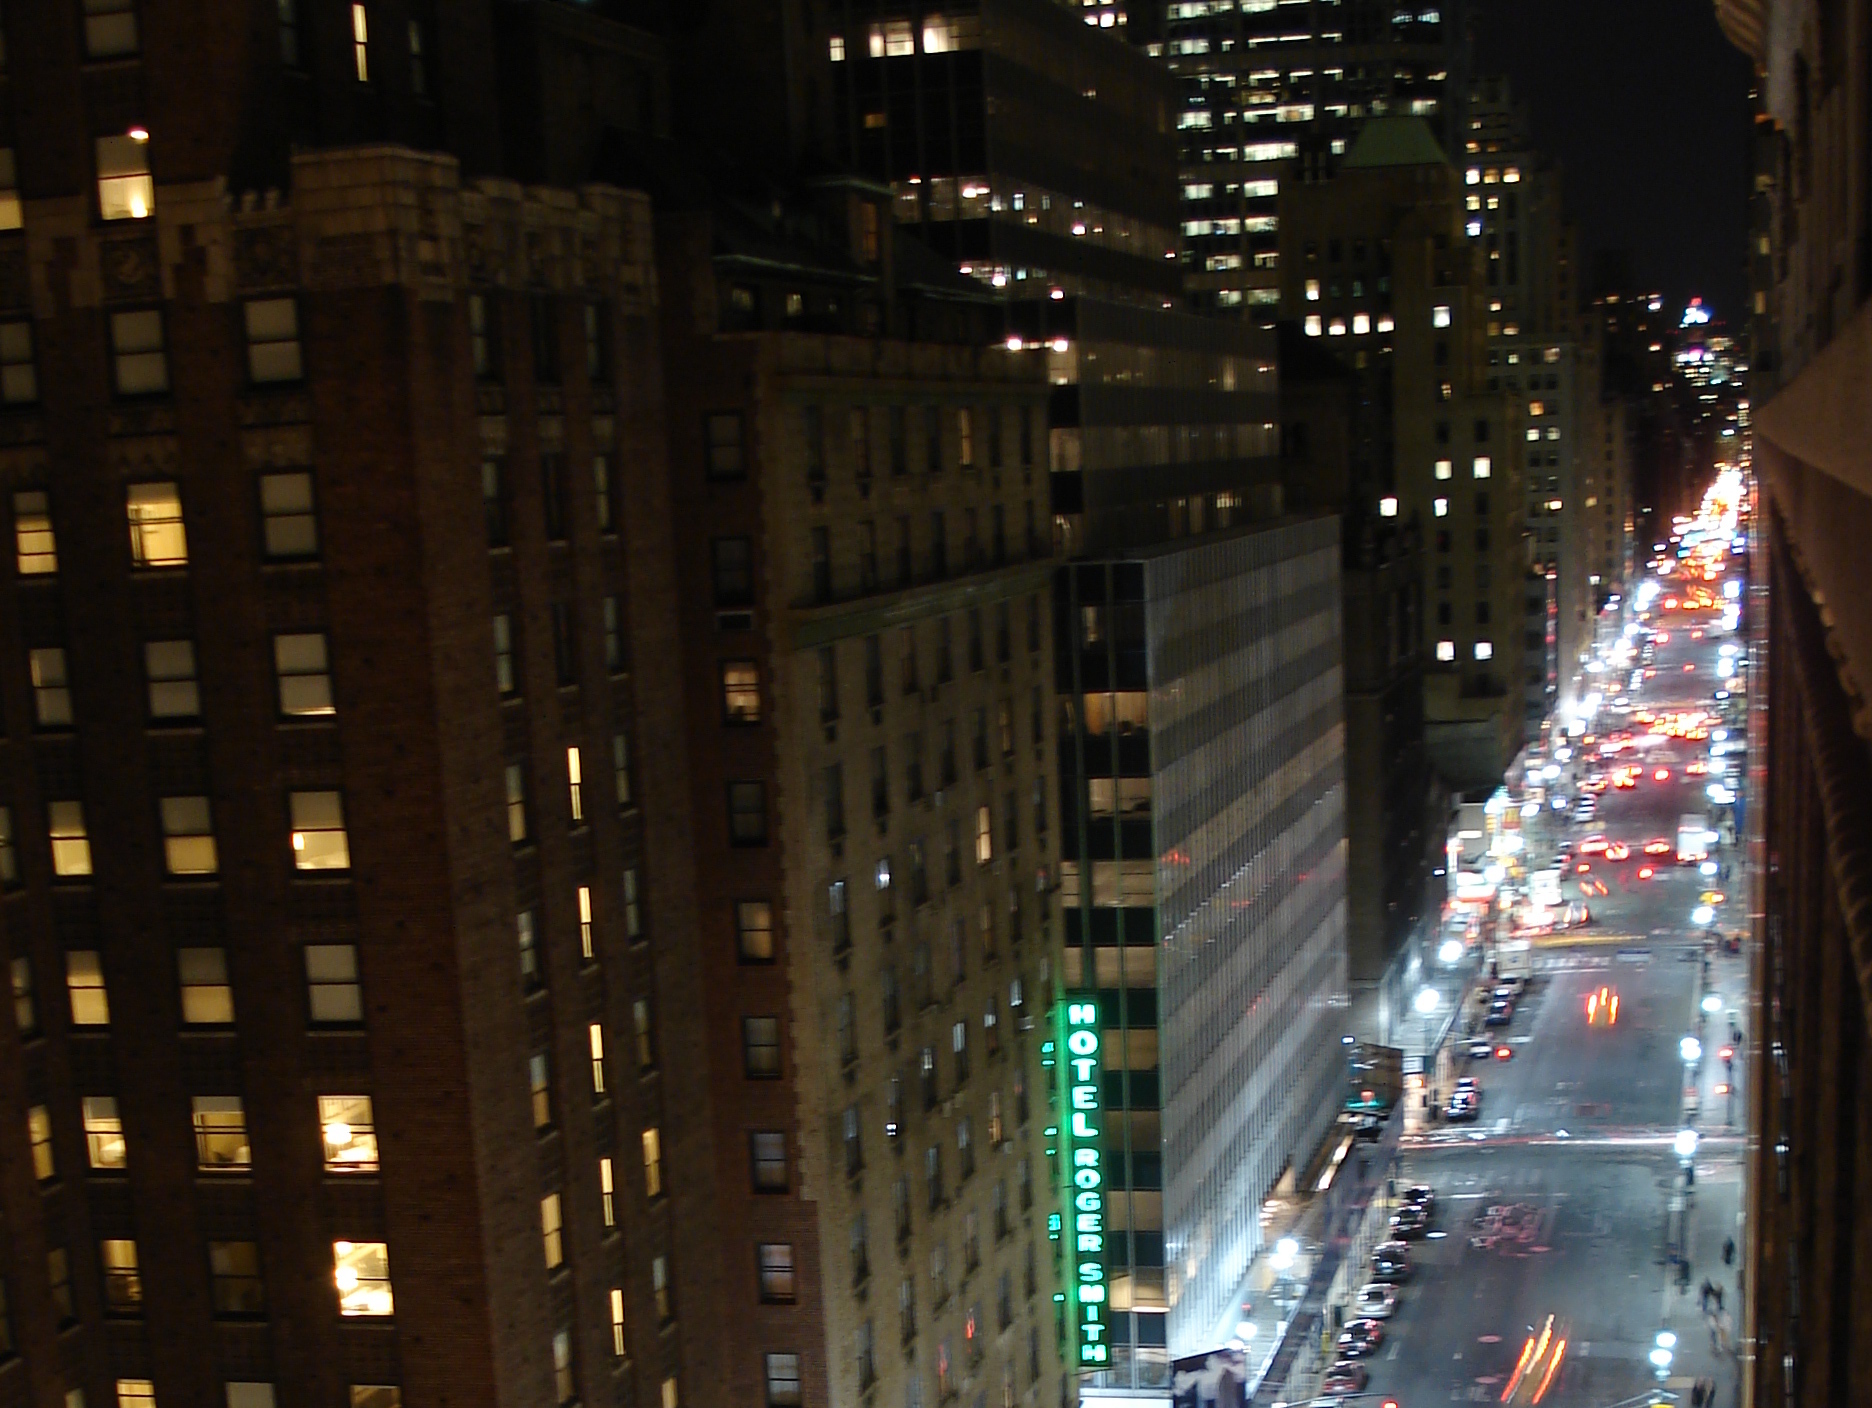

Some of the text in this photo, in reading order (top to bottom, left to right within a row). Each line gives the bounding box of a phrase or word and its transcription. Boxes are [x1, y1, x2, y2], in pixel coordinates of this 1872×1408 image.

[1068, 1004, 1107, 1362] HOTEL ROGER SMITH
